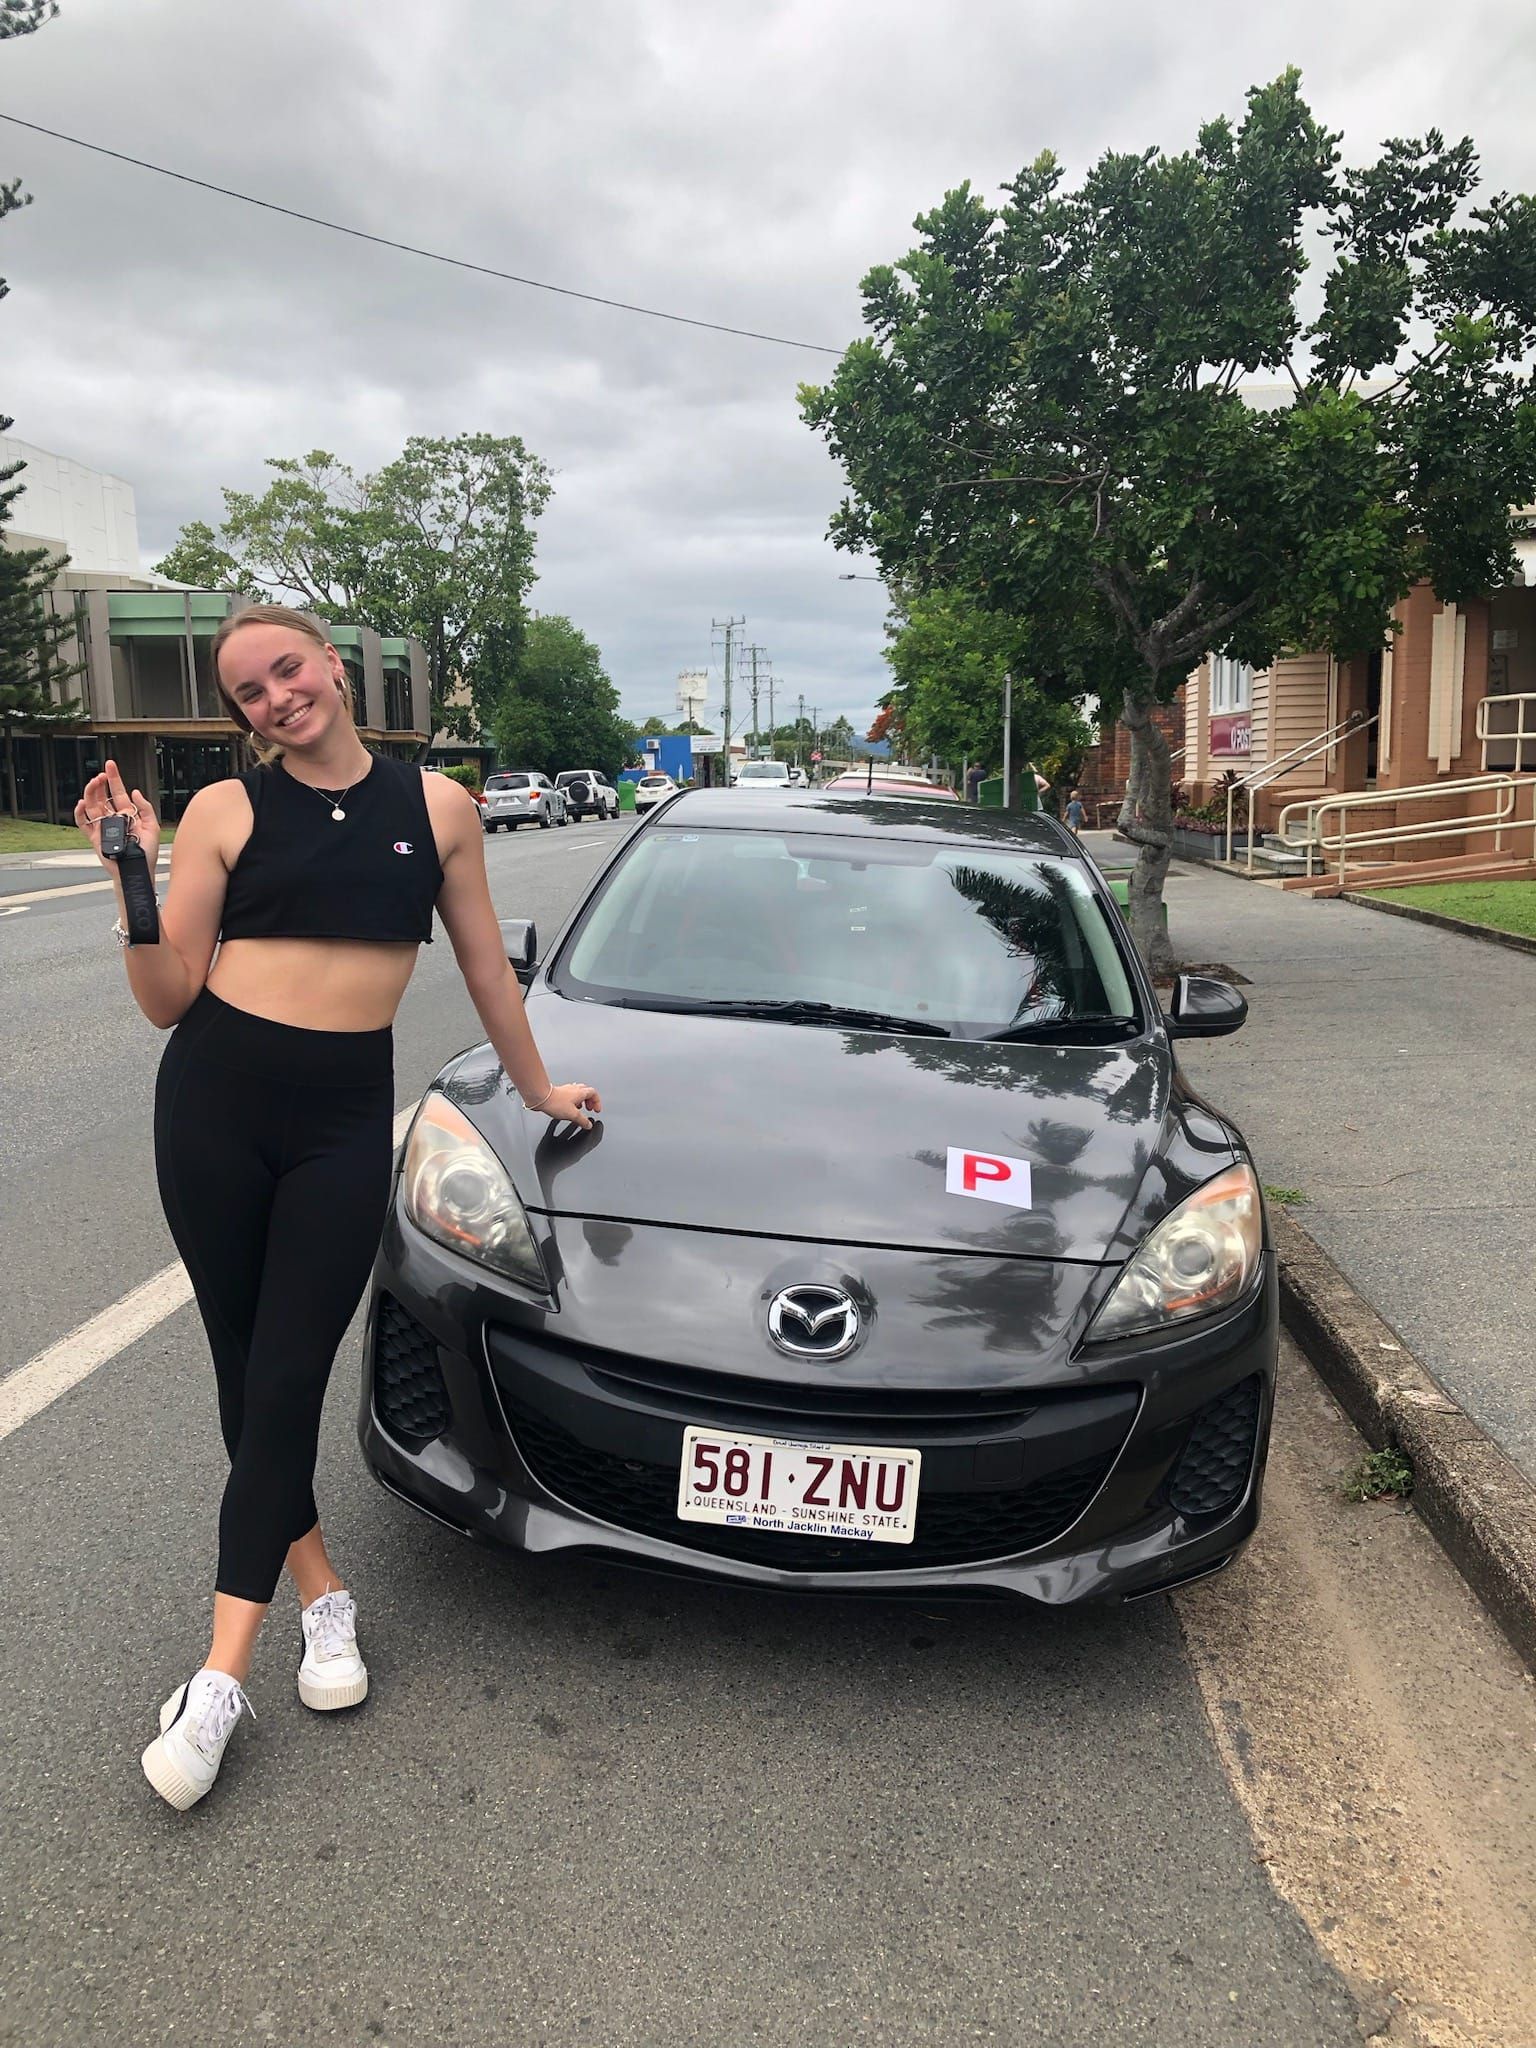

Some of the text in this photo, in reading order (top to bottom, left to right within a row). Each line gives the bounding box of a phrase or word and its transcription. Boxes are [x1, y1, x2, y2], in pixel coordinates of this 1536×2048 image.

[963, 1153, 1012, 1192] P
[693, 1495, 900, 1529] QUEENSLAND SUNSHINE STATE
[753, 1516, 784, 1529] North
[787, 1520, 827, 1534] Jacklin
[830, 1524, 874, 1540] Mackay
